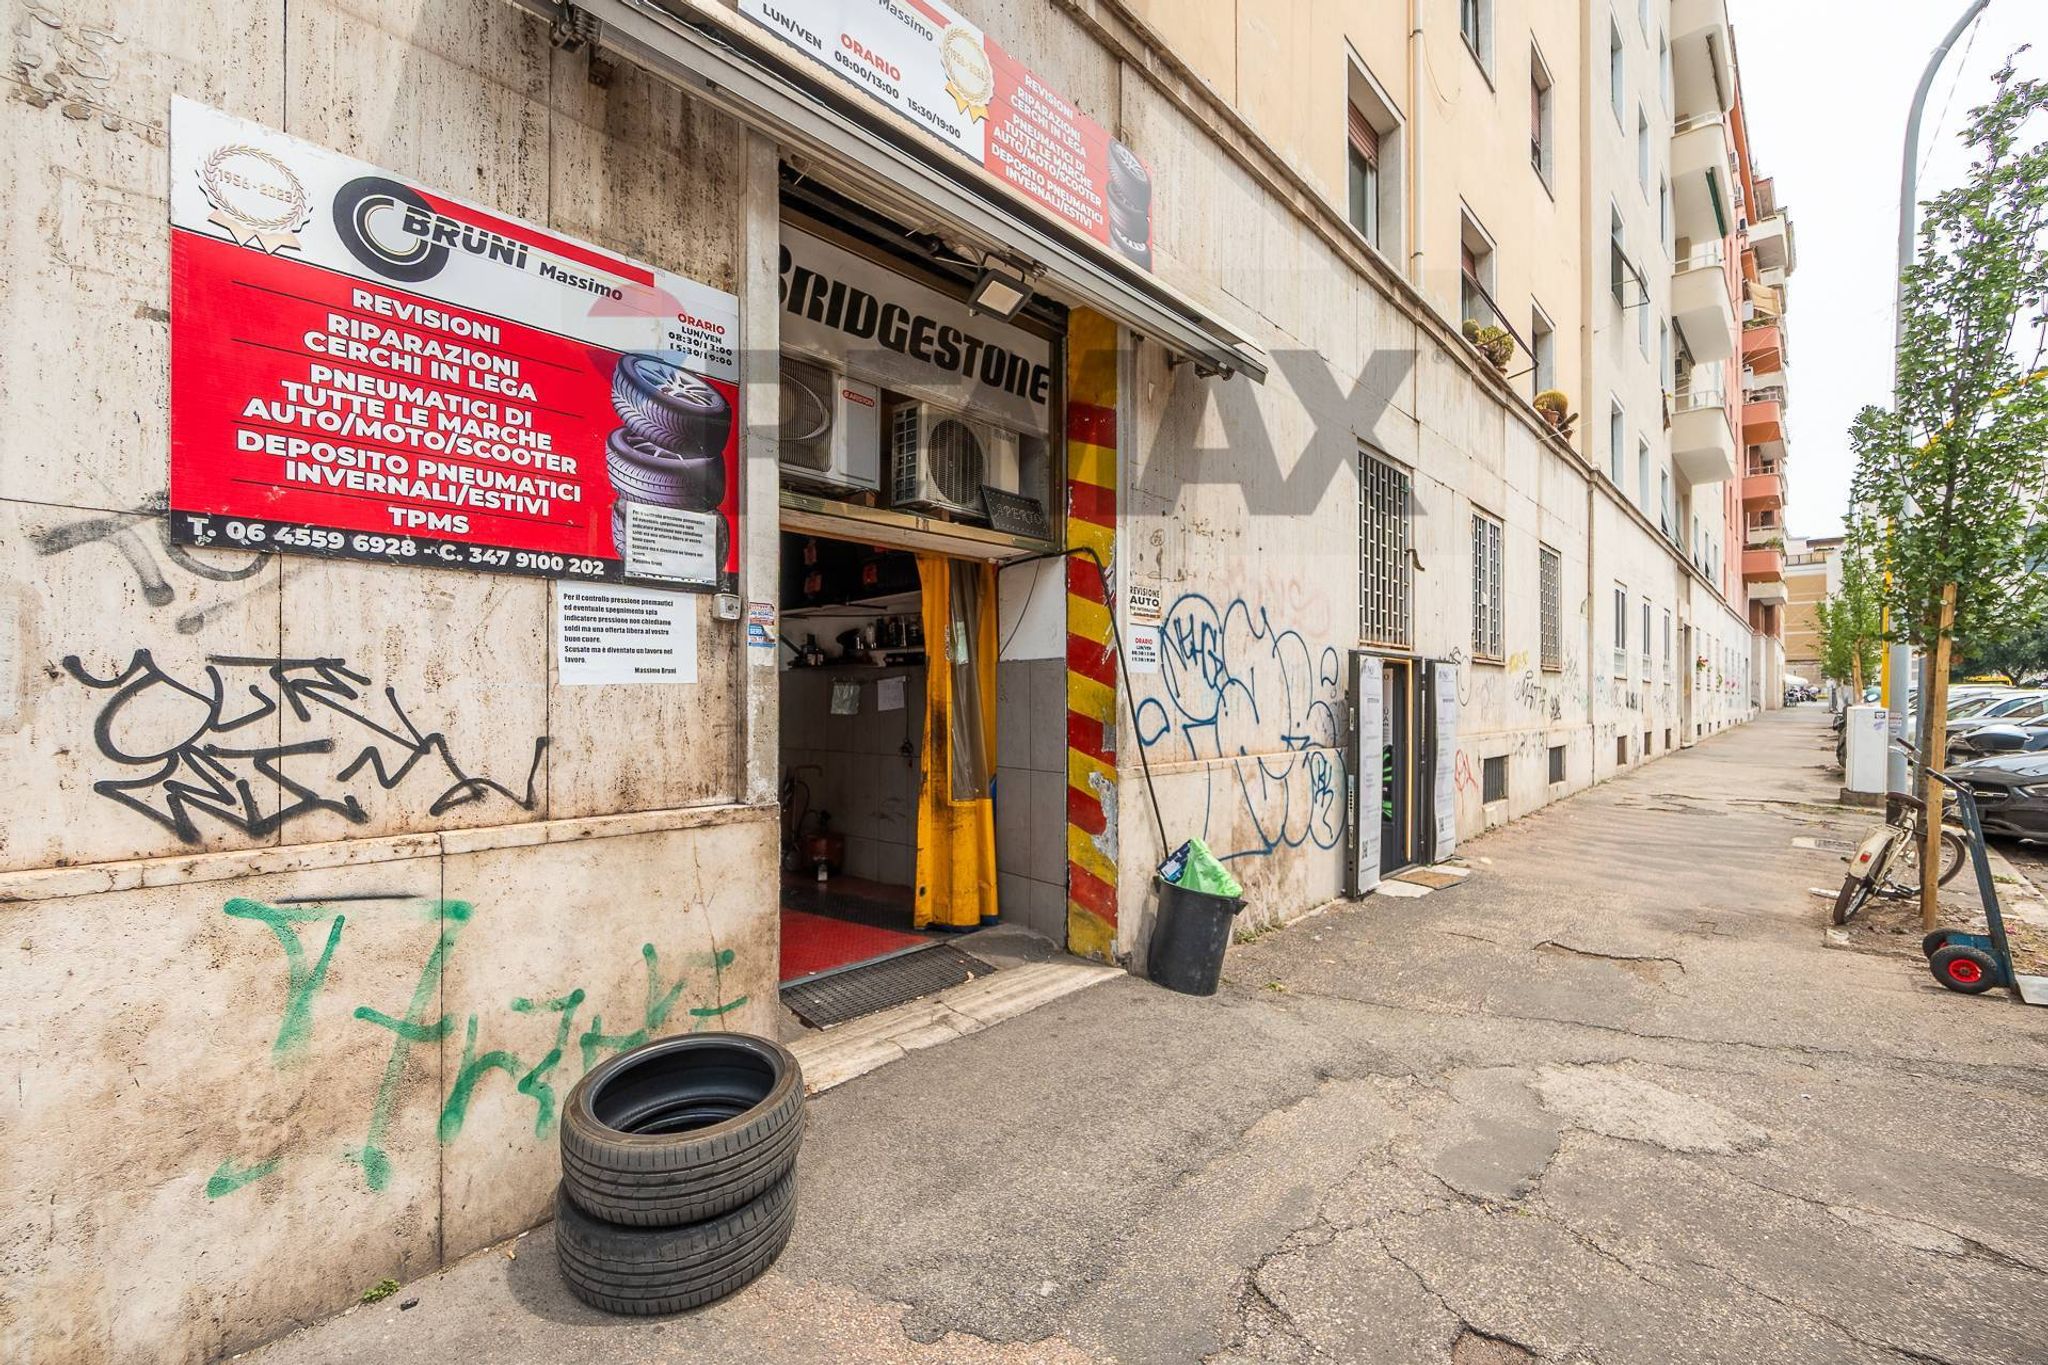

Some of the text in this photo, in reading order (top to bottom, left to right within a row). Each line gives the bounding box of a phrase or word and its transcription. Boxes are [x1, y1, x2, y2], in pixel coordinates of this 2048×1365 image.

[762, 3, 822, 50] LUN/VEN
[878, 0, 933, 42] Massimo
[840, 33, 901, 81] ORARIO
[834, 50, 899, 99] 08:00/13:00
[907, 97, 961, 139] 15:30/19:00
[1017, 86, 1081, 142] RIPARAZIONI
[1025, 74, 1073, 120] REVISIONI
[1004, 119, 1093, 190] TUTTE LE MARCHE
[1010, 94, 1087, 158] CERCHI IN LEGA
[1013, 113, 1086, 174] PNEUMATICI DI
[991, 142, 1104, 225] DEPOSITO PNEUMATICI
[993, 126, 1102, 207] AUTO/MOTO/SCOOTER
[1005, 165, 1092, 229] INVERNALI/ESTIVI
[402, 206, 624, 301] BRUNI Massimo
[352, 287, 501, 345] REVISIONI
[678, 313, 726, 335] ORARIO
[681, 326, 722, 344] LUN/VEN
[303, 331, 538, 402] CERCHI IN LEGA
[327, 313, 520, 379] RIPARAZIONI
[281, 380, 552, 450] TUTTE LE MARCHE
[310, 363, 533, 428] PNEUMATICI DI
[243, 397, 577, 475] AUTO/MOTO/SCOOTER
[236, 429, 581, 503] DEPOSITO PNEUMATICI
[285, 460, 550, 517] INVERNALI/ESTIVI
[187, 516, 217, 537] T.
[225, 521, 266, 541] 06
[274, 526, 345, 549] 4559
[353, 534, 417, 557] 6928
[469, 547, 510, 567] 347
[516, 551, 565, 571] 9100
[569, 558, 605, 576] 202
[388, 506, 470, 534] TPMS
[563, 593, 574, 601] Per
[564, 603, 572, 611] ed
[573, 605, 604, 613] eventuale
[1129, 595, 1160, 607] AUTO
[1130, 586, 1160, 598] REVISIONE
[564, 645, 590, 653] Scusate
[598, 616, 628, 624] pressione
[641, 618, 671, 626] chiediamo
[626, 626, 644, 634] libera
[1135, 637, 1153, 645] ORARIO
